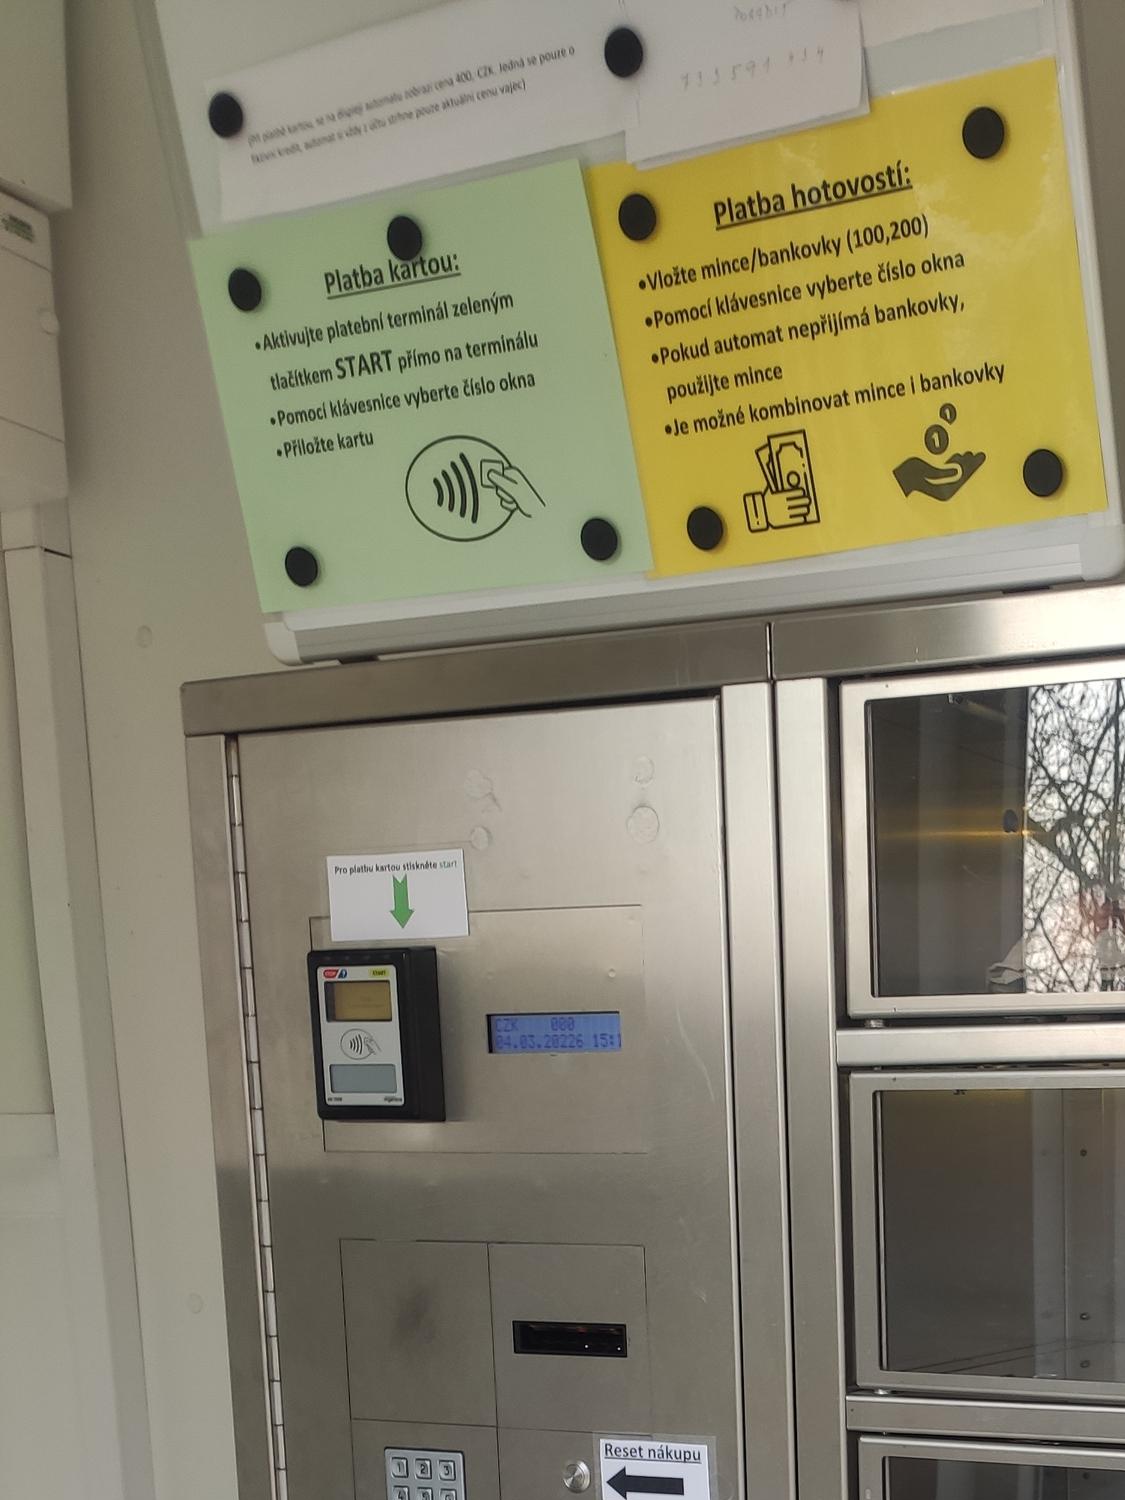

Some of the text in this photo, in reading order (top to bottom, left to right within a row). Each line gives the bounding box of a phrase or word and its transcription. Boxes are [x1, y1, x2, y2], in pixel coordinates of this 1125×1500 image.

[539, 47, 567, 66] pouze
[568, 45, 575, 56] o
[713, 160, 912, 225] Platba hotovostí:
[324, 254, 460, 294] Platba kartou:
[646, 213, 929, 291] Vložte mince/bankovky (100,200)
[653, 252, 965, 329] Pomocí klávesnice vyberte číslo okna
[263, 291, 514, 351] Aktivujte platební terminál zeleným
[660, 291, 966, 365] Pokud automat nepřijímá bankovky,
[270, 330, 539, 391] tlačítkem START přímo na terminálu
[667, 365, 784, 405] použijte mince
[277, 371, 536, 427] Pomocí klávesnice vyberte číslo okna
[673, 361, 1005, 436] Je možné kombinovat mince i bankovky
[283, 431, 374, 459] Přiložte kartu
[334, 865, 348, 876] Pro
[349, 863, 374, 877] platbu
[375, 862, 401, 873] kartou
[402, 859, 438, 872] stiskněte
[495, 1017, 519, 1033] CZK
[604, 1442, 701, 1463] Reset nákupu
